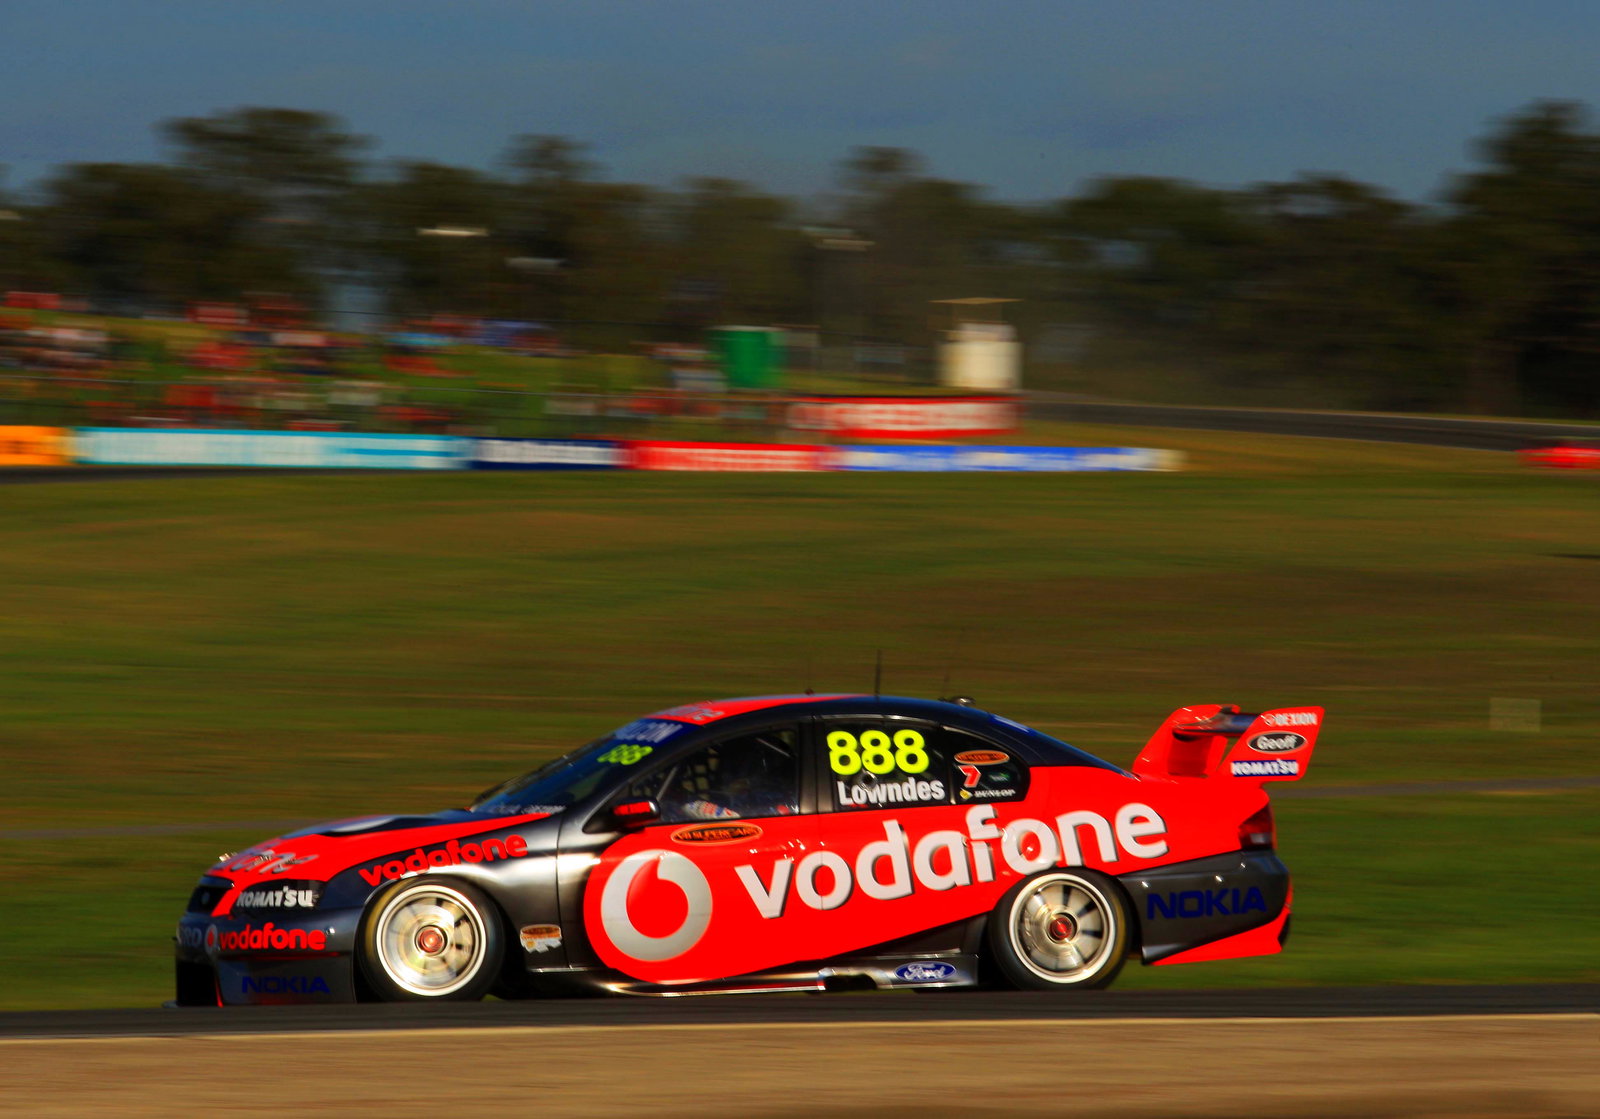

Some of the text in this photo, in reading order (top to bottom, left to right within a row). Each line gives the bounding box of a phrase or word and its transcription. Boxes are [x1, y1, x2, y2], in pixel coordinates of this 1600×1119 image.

[827, 729, 929, 775] 888
[1231, 758, 1298, 775] KOMATSU
[837, 776, 945, 806] Lowndes
[358, 834, 528, 887] vodafone
[734, 803, 1169, 919] vodafone
[236, 885, 314, 908] KOMATSU
[1147, 886, 1268, 920] NOKIA
[219, 922, 327, 950] vodafone
[242, 976, 331, 994] NOKIA
[903, 963, 946, 980] Ford
